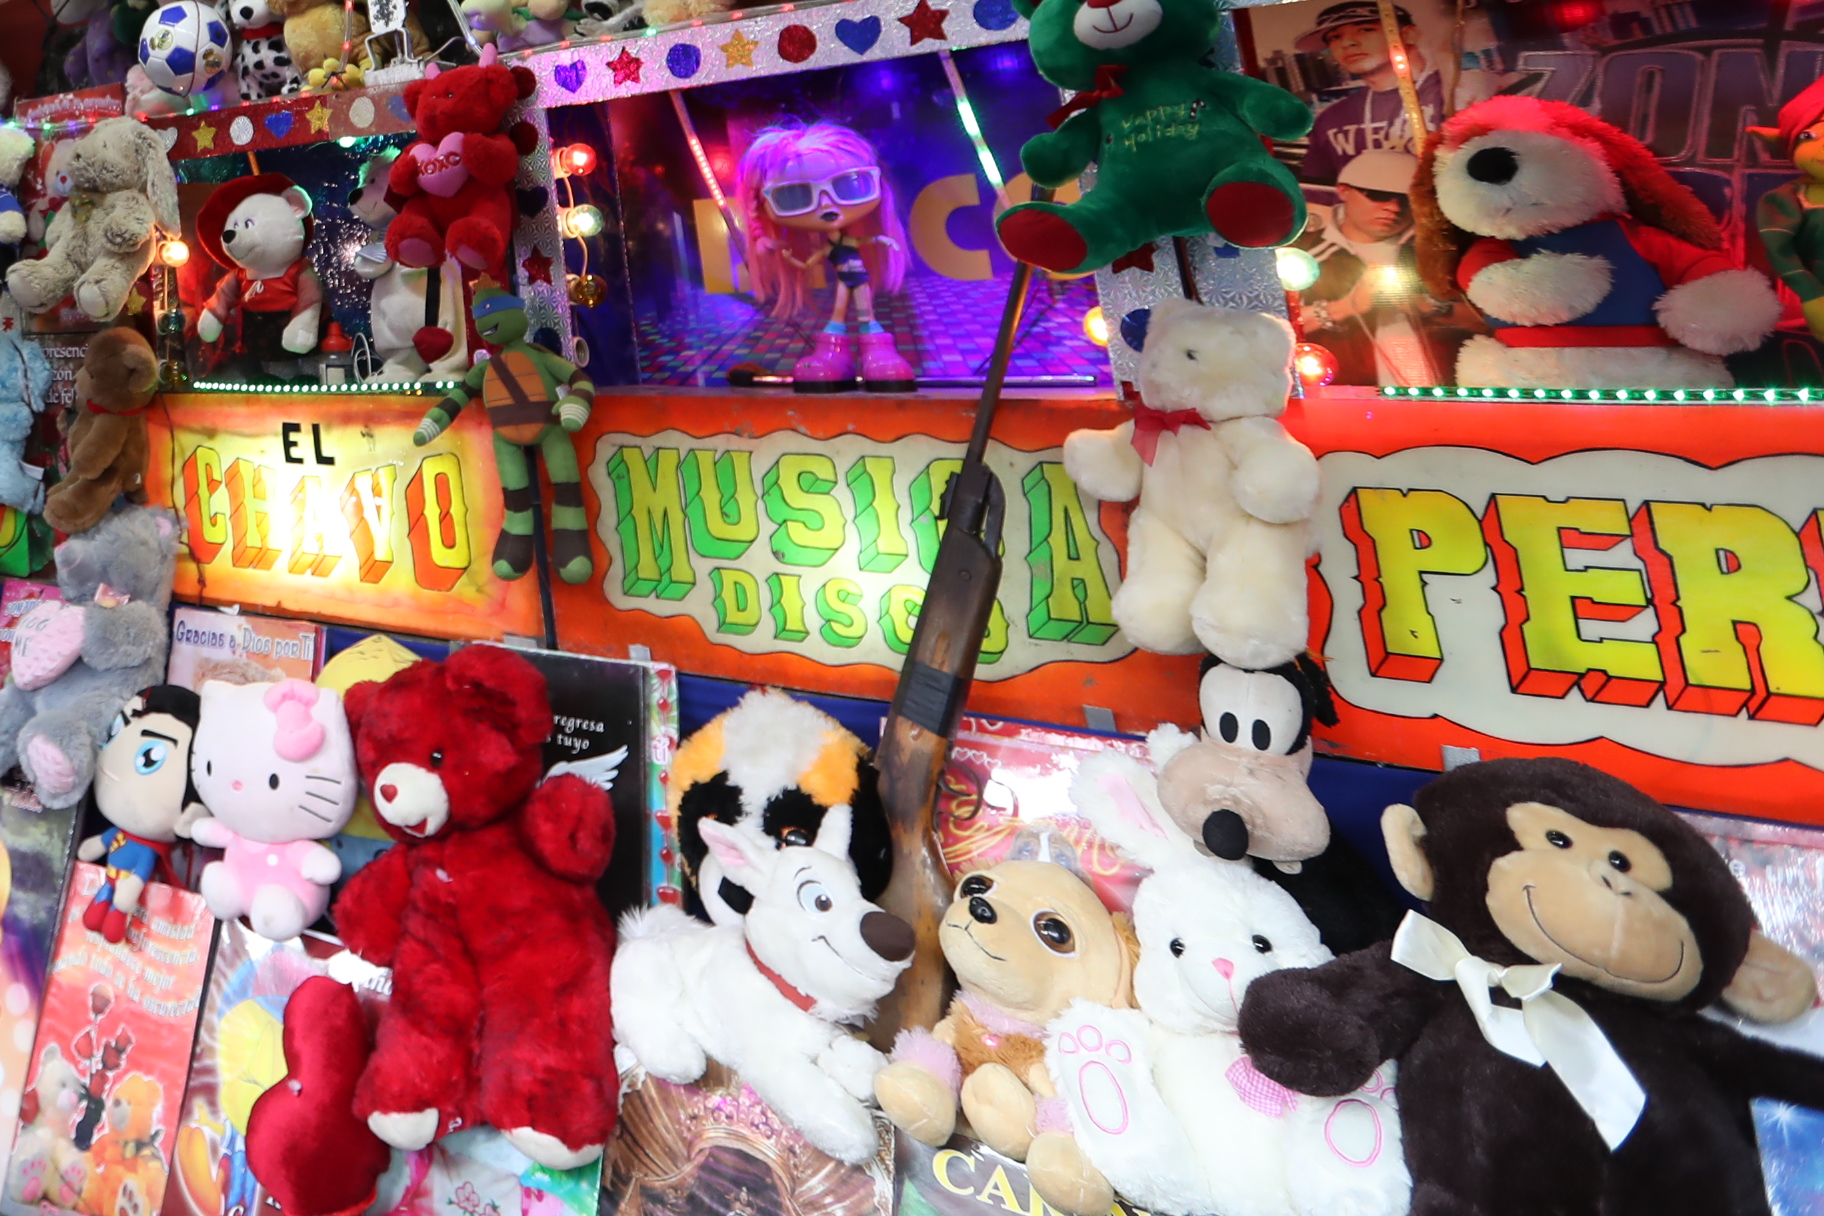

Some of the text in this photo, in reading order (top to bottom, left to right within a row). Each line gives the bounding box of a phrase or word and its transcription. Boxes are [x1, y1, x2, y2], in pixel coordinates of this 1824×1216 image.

[282, 422, 335, 466] EL
[182, 444, 472, 593] CHAVO
[710, 567, 1009, 665] DISC
[1339, 486, 1824, 727] PER
[241, 627, 272, 653] Dios
[553, 714, 605, 734] regresa
[556, 733, 590, 755] tuyo
